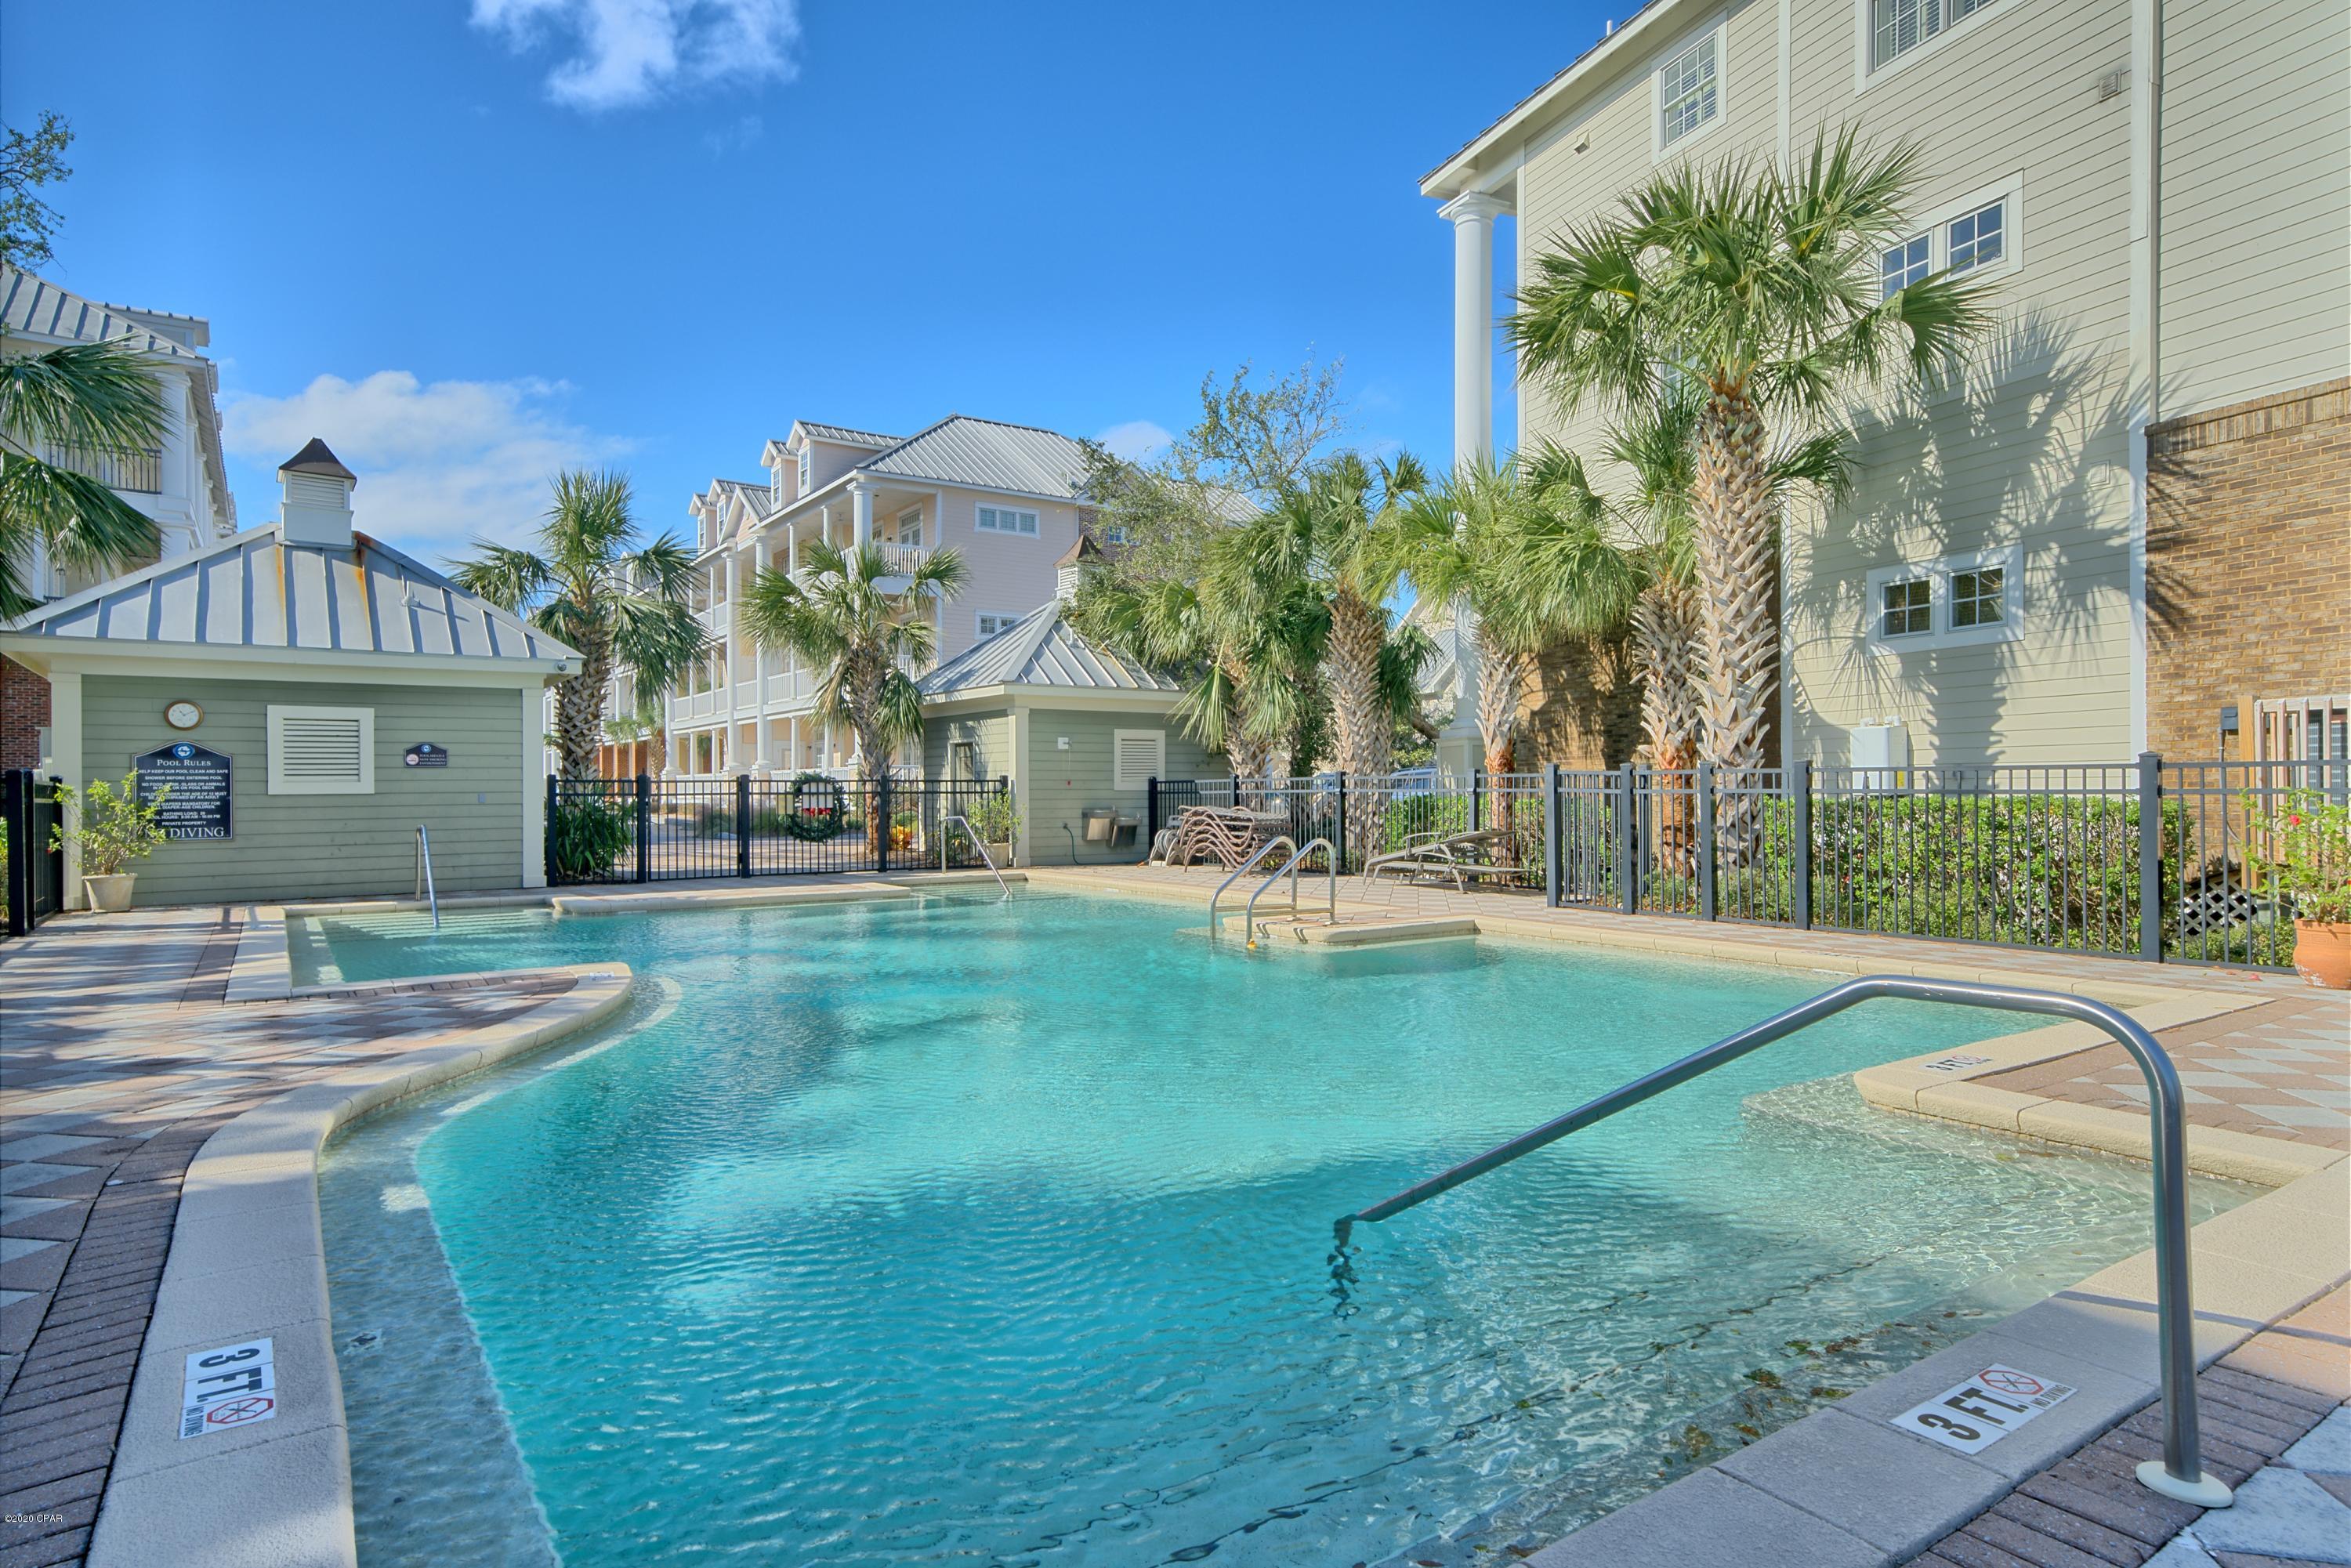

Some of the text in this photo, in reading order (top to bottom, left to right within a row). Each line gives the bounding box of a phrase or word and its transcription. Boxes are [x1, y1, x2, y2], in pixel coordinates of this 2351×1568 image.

[170, 827, 224, 838] DIVING
[198, 1348, 260, 1367] 3
[1917, 1413, 1981, 1441] 3
